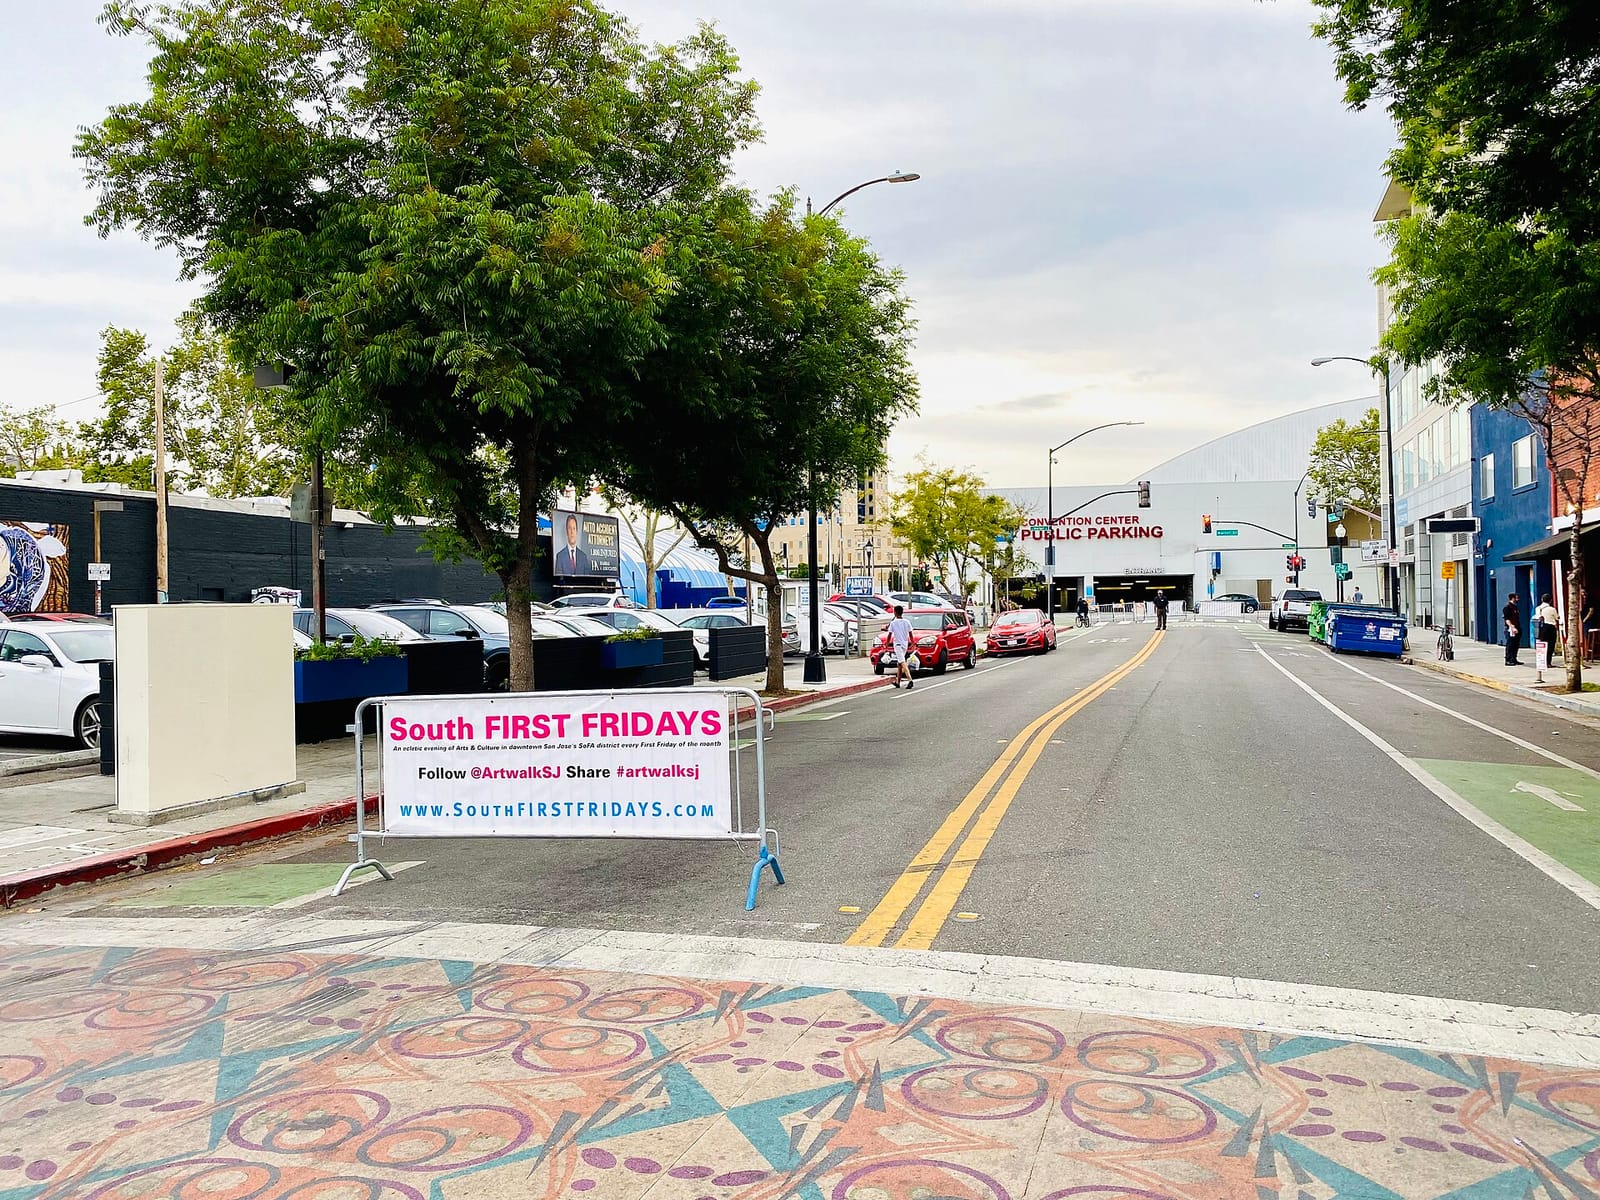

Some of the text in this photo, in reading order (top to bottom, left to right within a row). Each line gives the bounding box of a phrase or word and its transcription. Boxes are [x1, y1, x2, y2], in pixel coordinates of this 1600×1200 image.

[1022, 515, 1140, 526] CONVENTION CENTER
[1021, 526, 1164, 541] PUBLIC PARKING
[847, 578, 872, 587] PARKING
[390, 709, 722, 741] South FIRST FRIDAYS
[423, 745, 447, 753] evening
[620, 742, 640, 750] every
[656, 741, 677, 749] Friday
[418, 764, 700, 781] Follow @ArtwalkSJ Share #artwalksj
